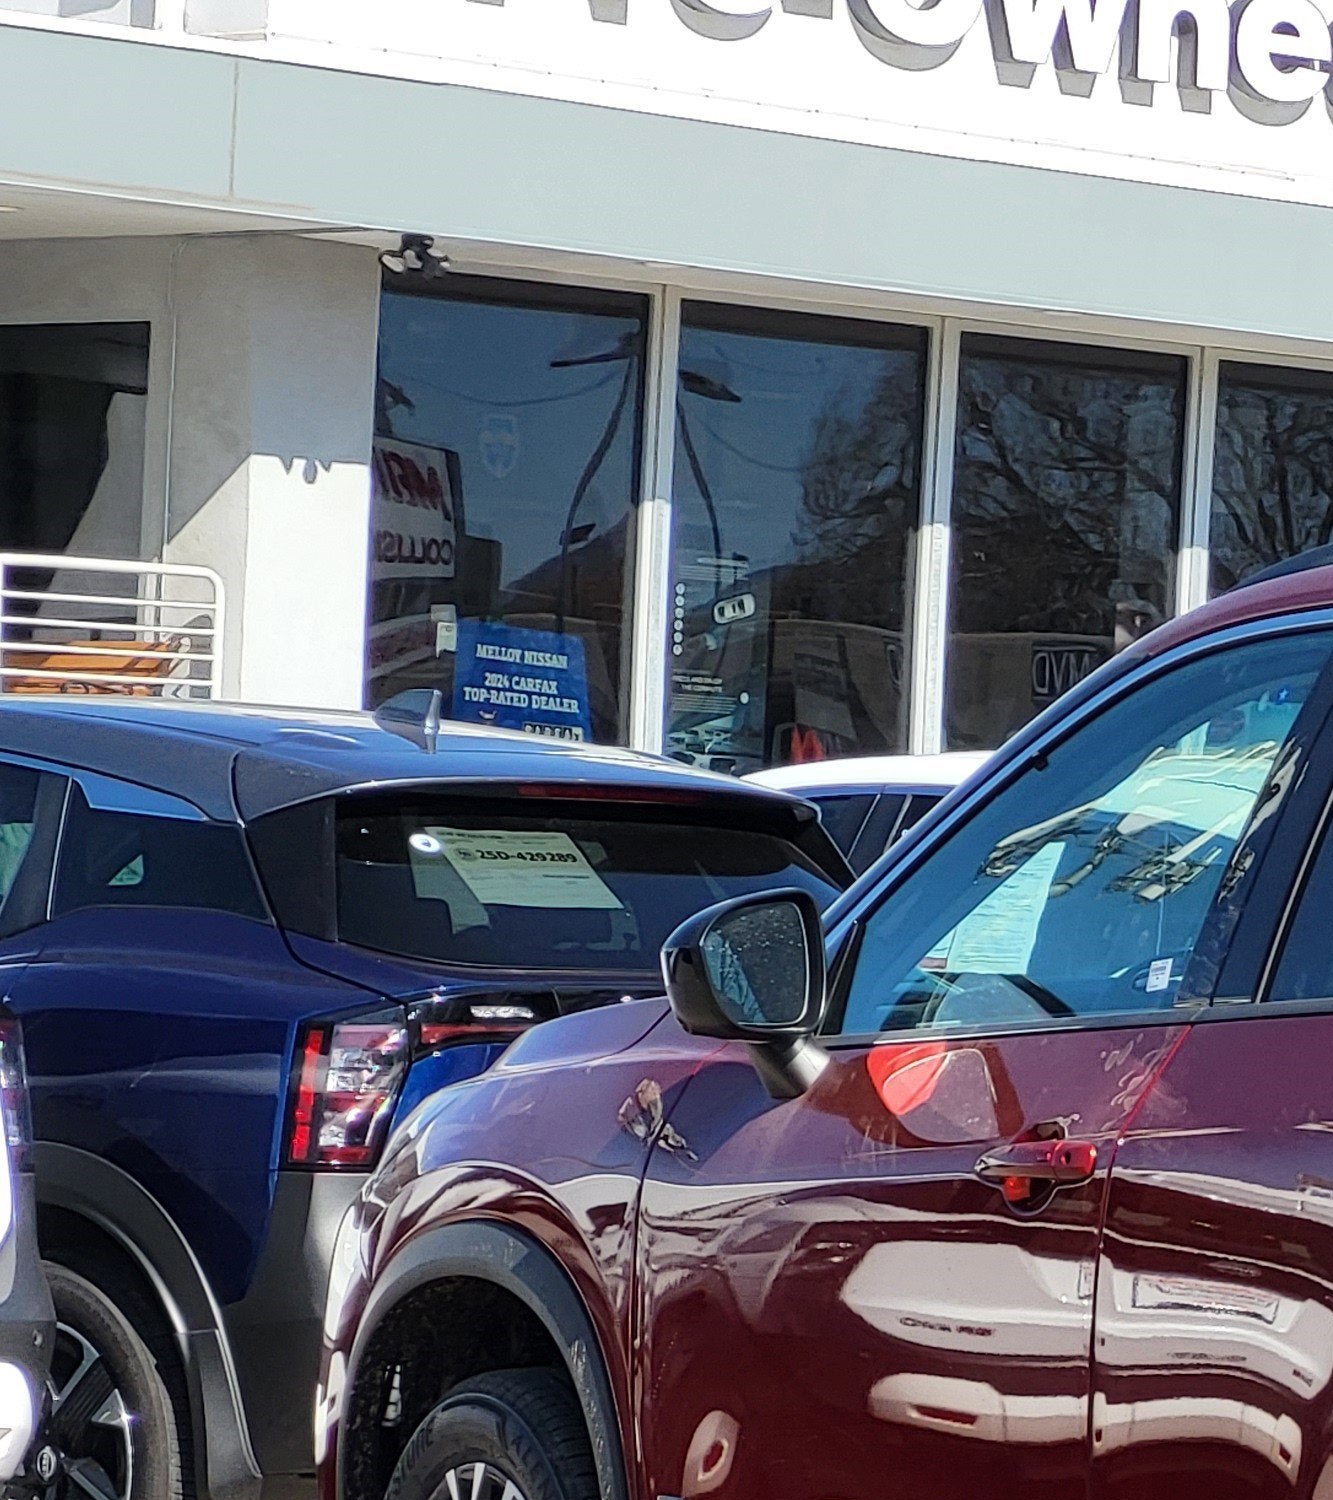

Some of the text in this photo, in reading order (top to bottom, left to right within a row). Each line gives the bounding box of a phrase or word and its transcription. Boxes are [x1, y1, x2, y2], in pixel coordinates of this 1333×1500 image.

[475, 643, 568, 669] MELLOY NISSAN
[484, 672, 558, 694] 2024 CARFAX
[463, 687, 580, 713] TOP-RATED DEALER
